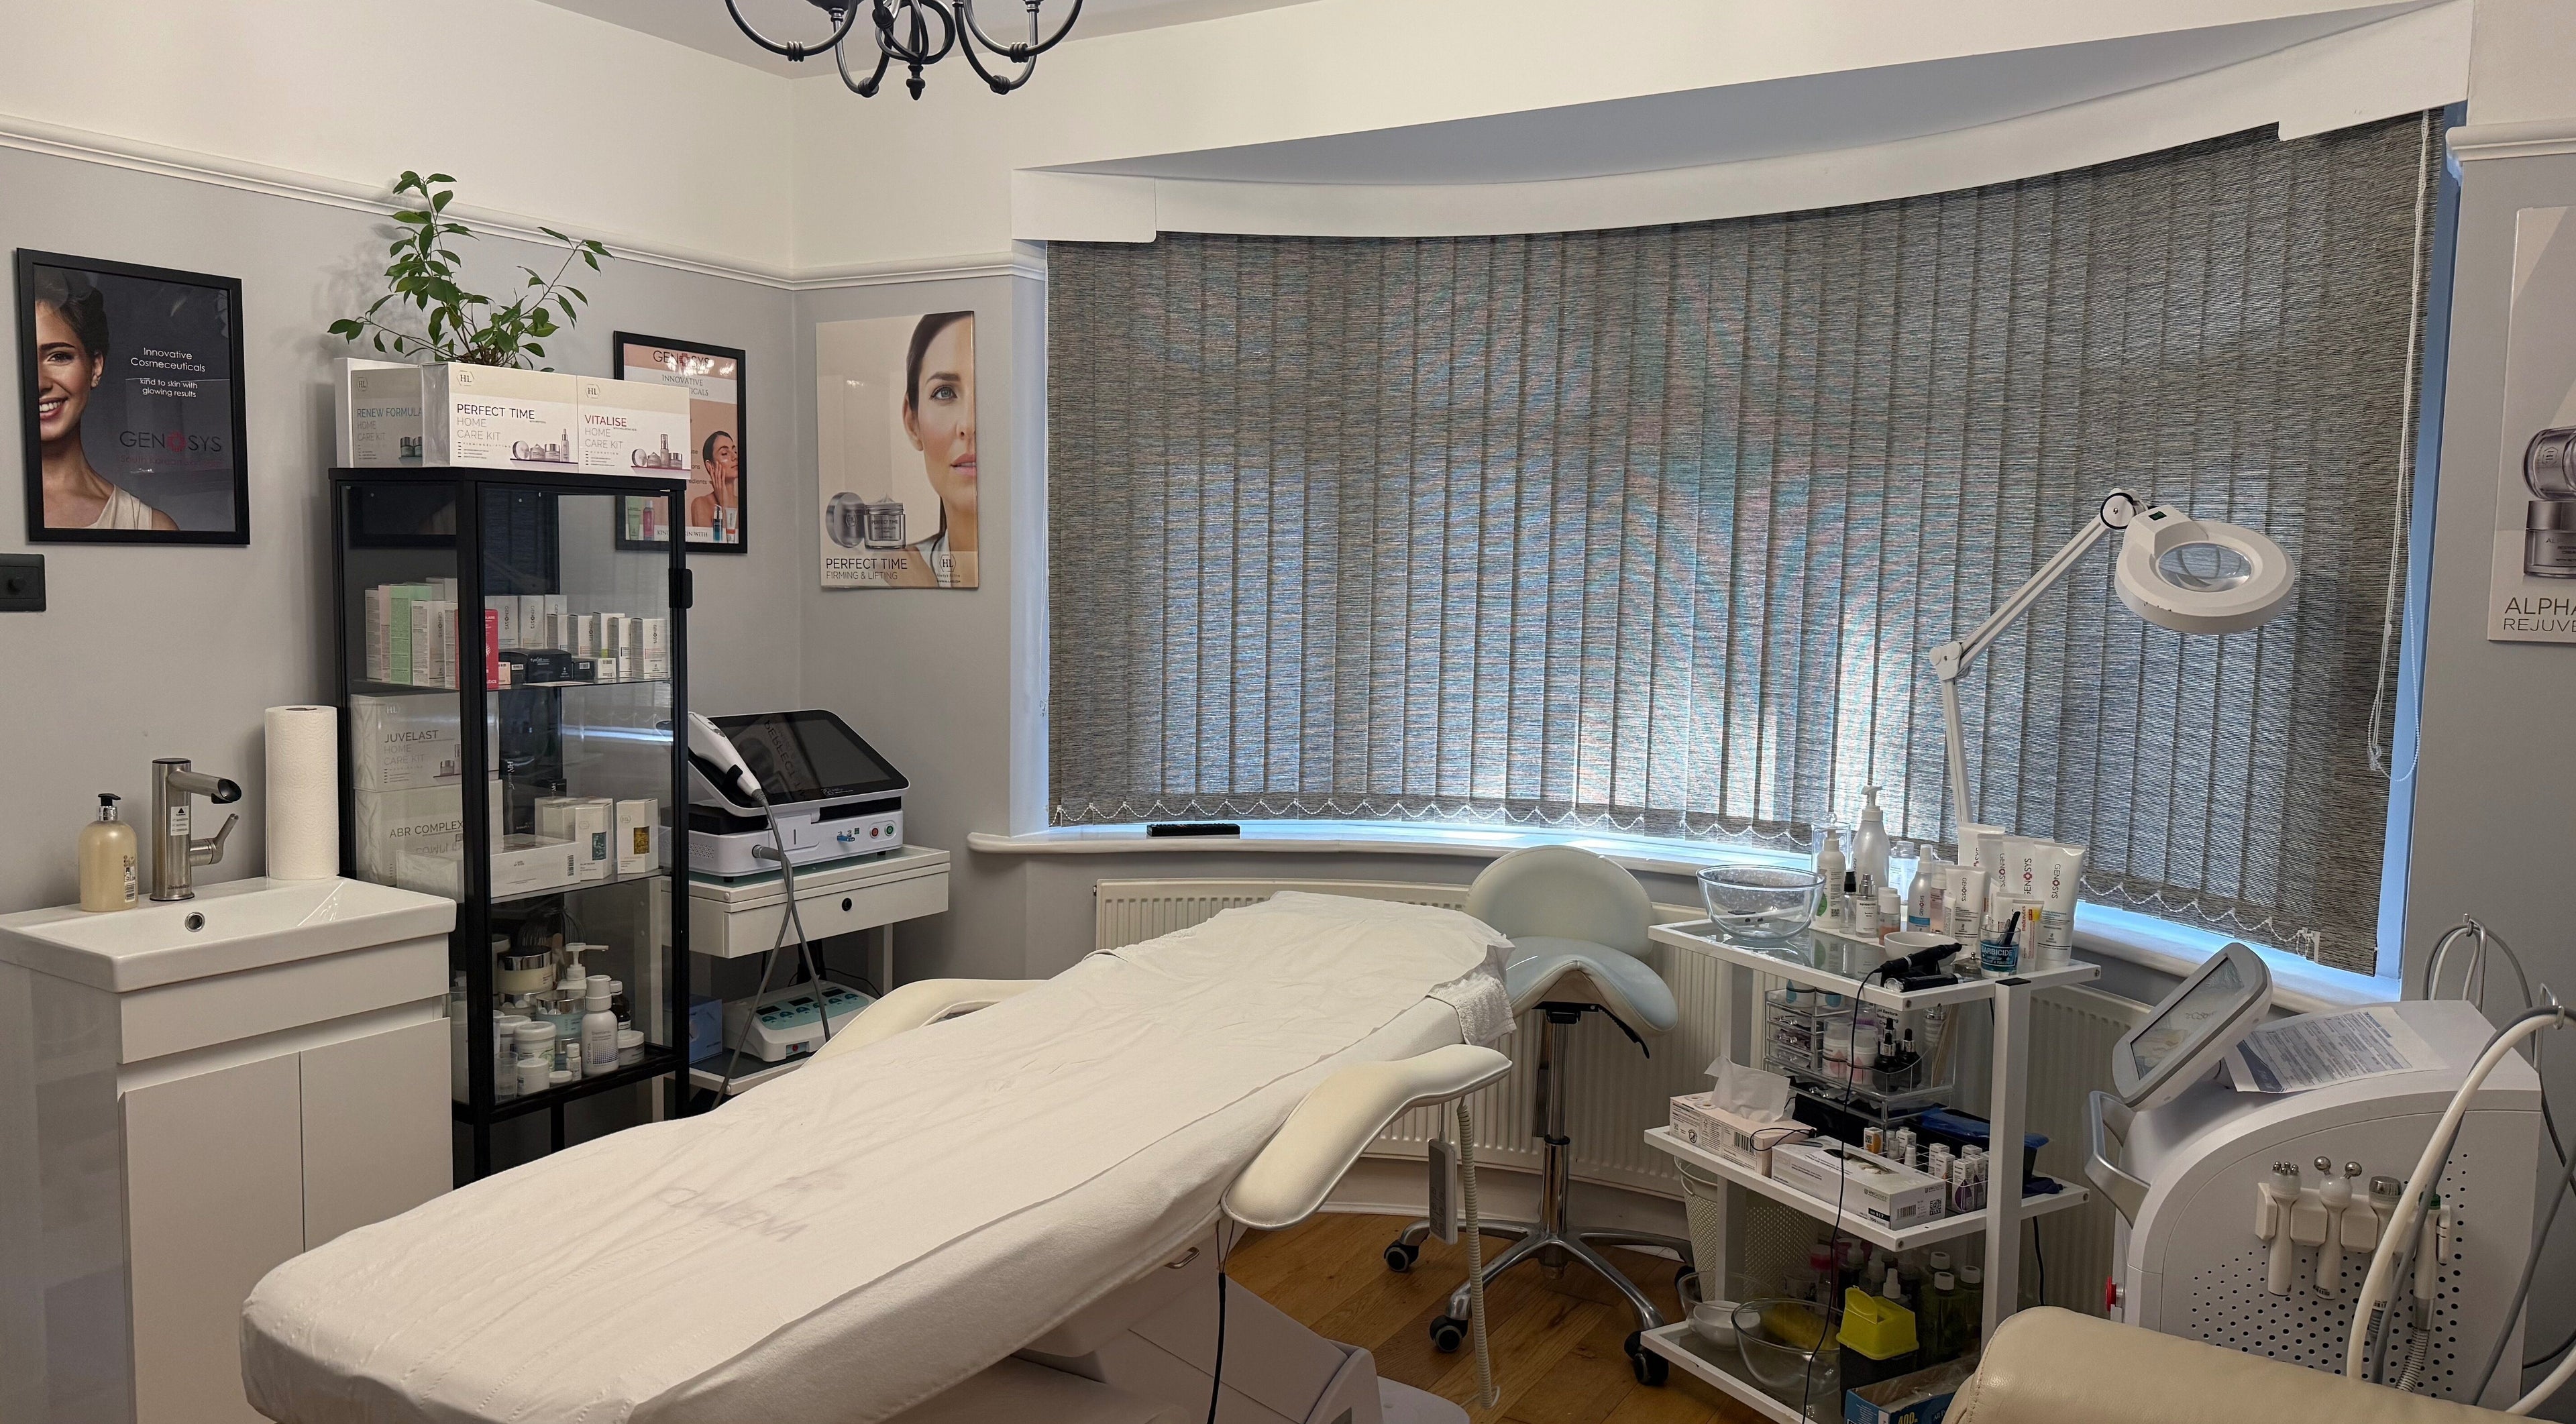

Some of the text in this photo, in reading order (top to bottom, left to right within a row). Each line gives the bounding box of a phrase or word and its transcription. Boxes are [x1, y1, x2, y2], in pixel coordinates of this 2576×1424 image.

[144, 347, 193, 360] Innovative
[130, 358, 205, 372] Cosmeceuticals
[140, 378, 156, 386] kind
[167, 380, 181, 388] skin
[182, 381, 198, 389] with
[460, 374, 472, 383] HL
[662, 374, 703, 386] INNOVATIVE
[142, 388, 197, 398] glowing results
[357, 407, 422, 418] RENEW FORMULA
[457, 404, 535, 420] PERFECT TIME
[357, 421, 376, 430] HOME
[457, 417, 487, 428] HOME
[584, 415, 627, 427] VITALISE
[358, 433, 375, 442] CARE
[457, 429, 501, 441] CARE KIT
[585, 427, 611, 437] HOME
[119, 431, 222, 452] GENOSYS
[585, 439, 623, 449] CARE KIT
[826, 557, 908, 569] PERFECT TIME
[943, 559, 954, 567] HL
[826, 571, 898, 580] FIRMING & LIFTING
[384, 730, 439, 743] JUVELAST
[384, 744, 412, 754] HOME
[384, 755, 409, 765] CARE
[389, 820, 463, 838] ABR COMPLEX
[2051, 863, 2061, 899] GENOSYS
